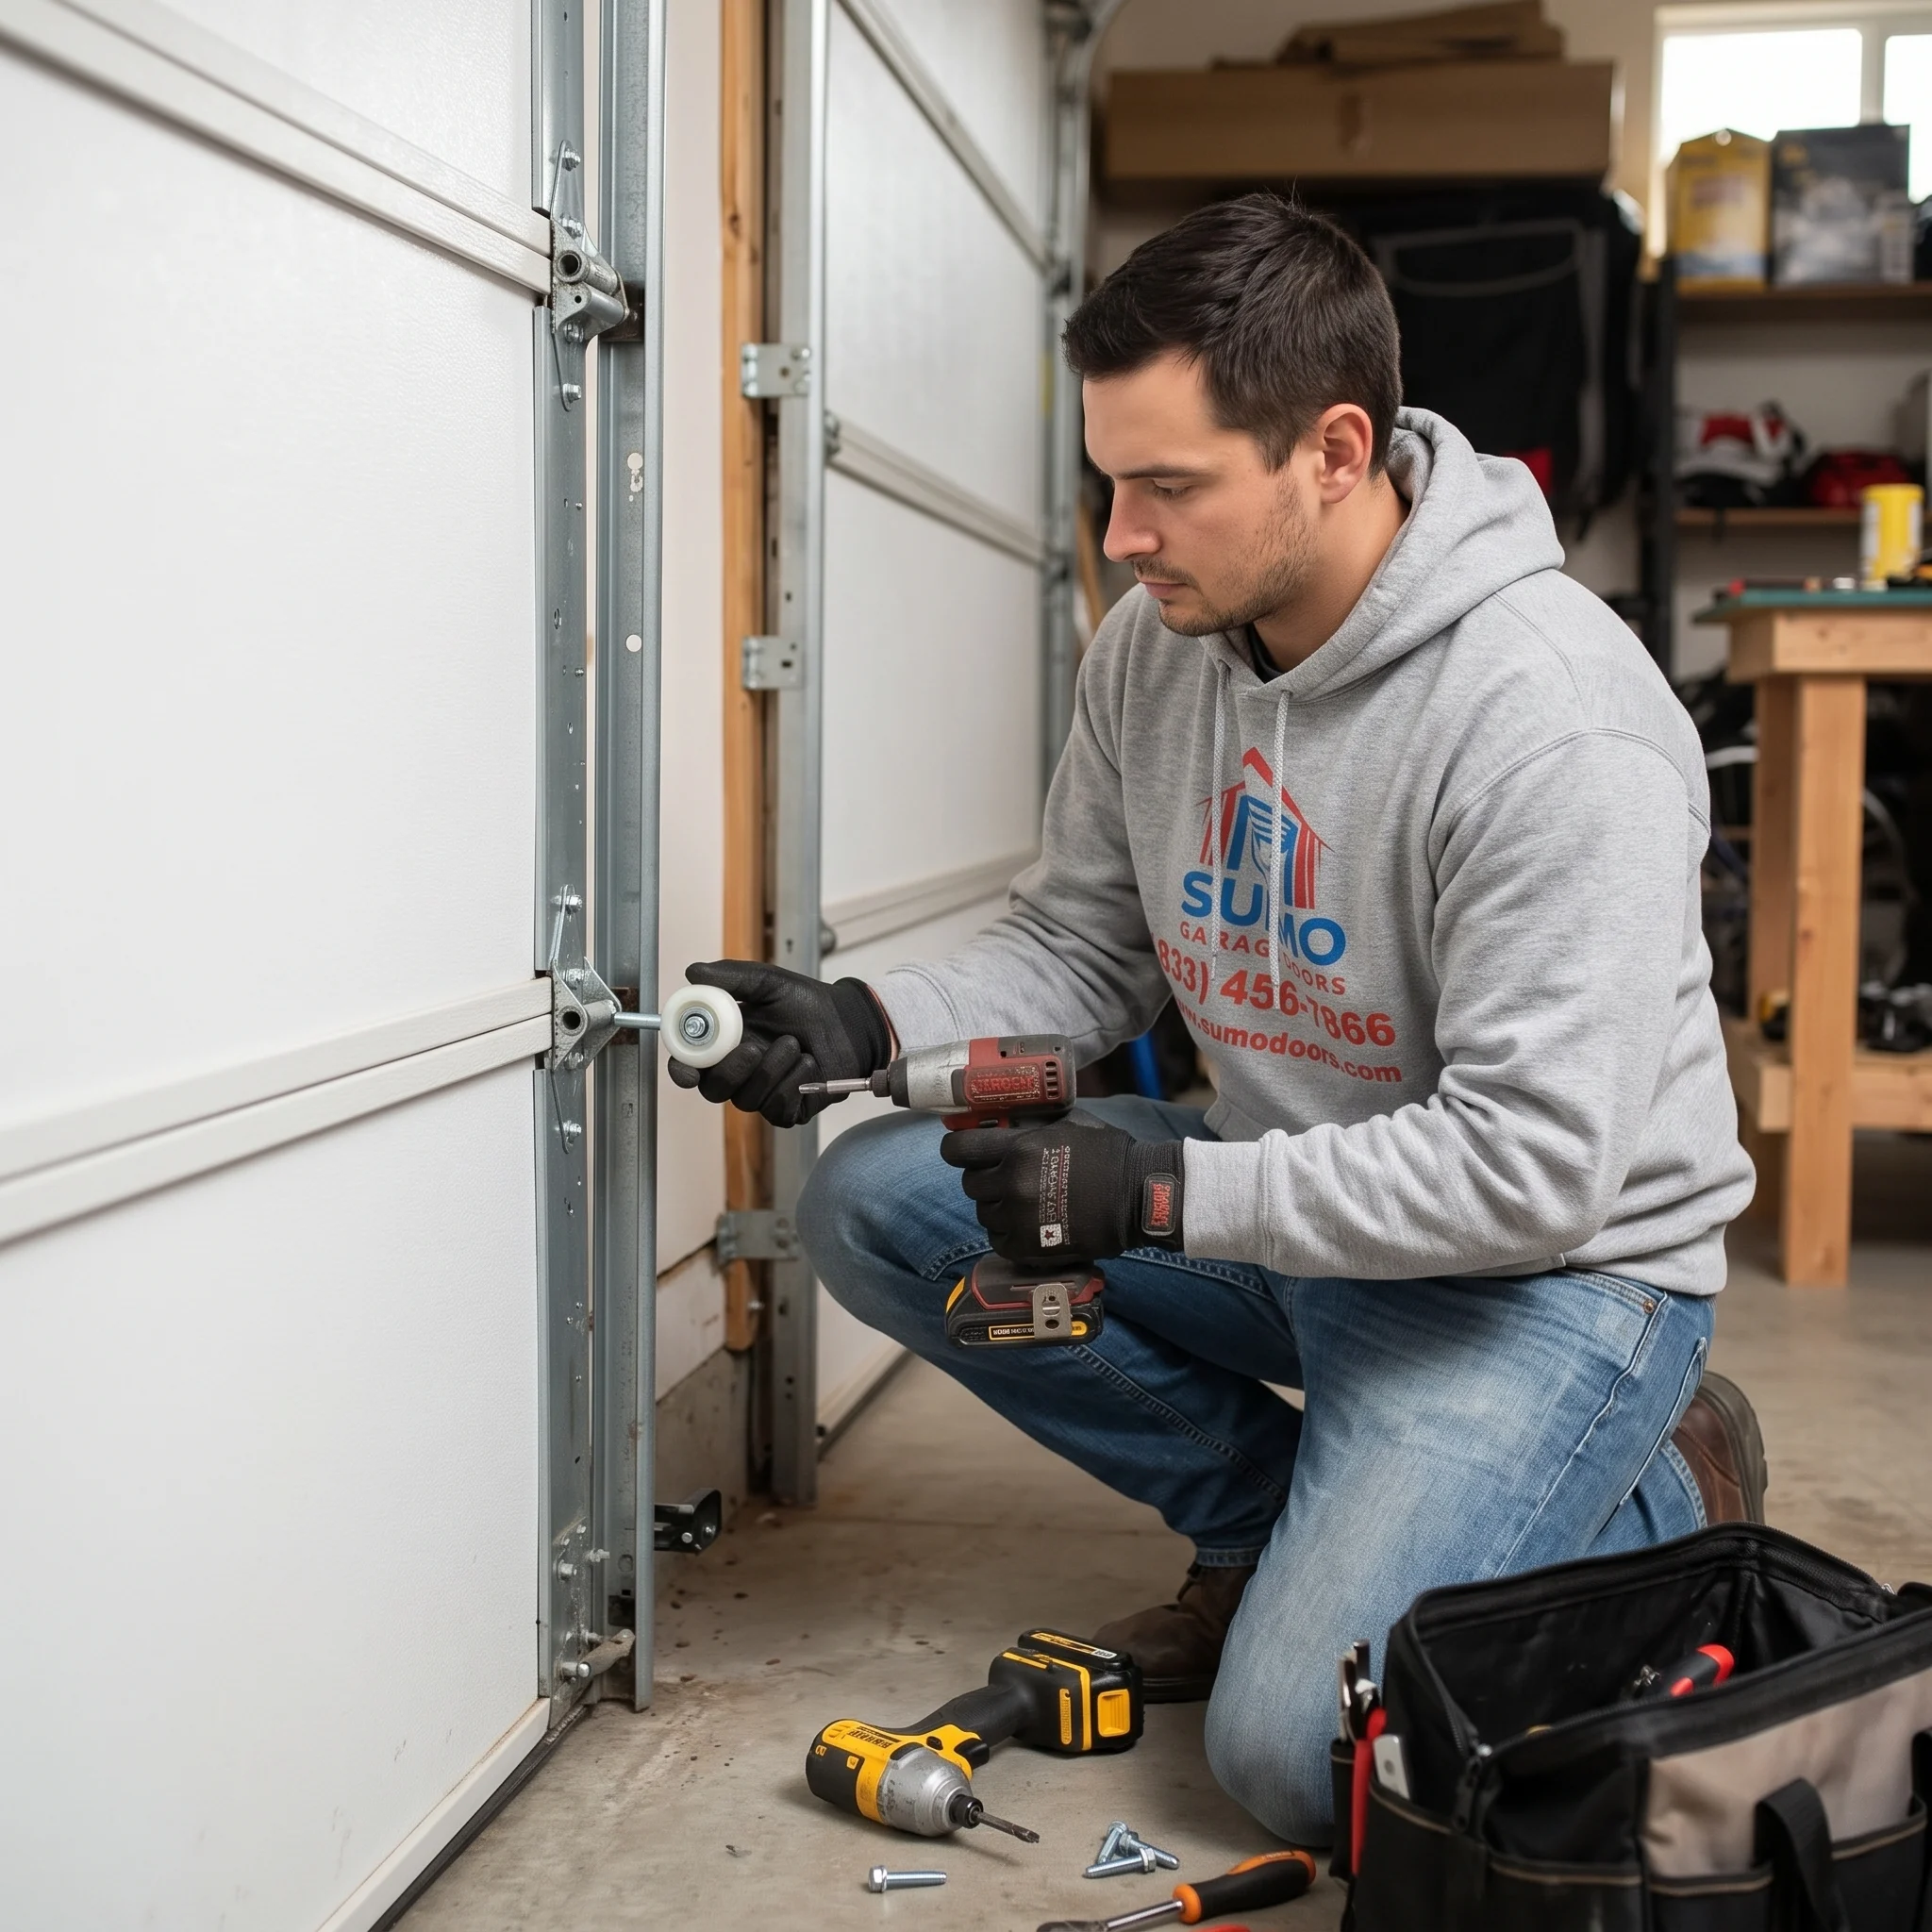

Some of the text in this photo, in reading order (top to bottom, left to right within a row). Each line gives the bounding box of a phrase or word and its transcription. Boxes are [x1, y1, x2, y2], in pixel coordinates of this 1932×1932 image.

[1180, 921, 1346, 995] GARAG DOORS
[1181, 871, 1346, 966] SUMO
[1151, 932, 1396, 1047] 833) 456-7866
